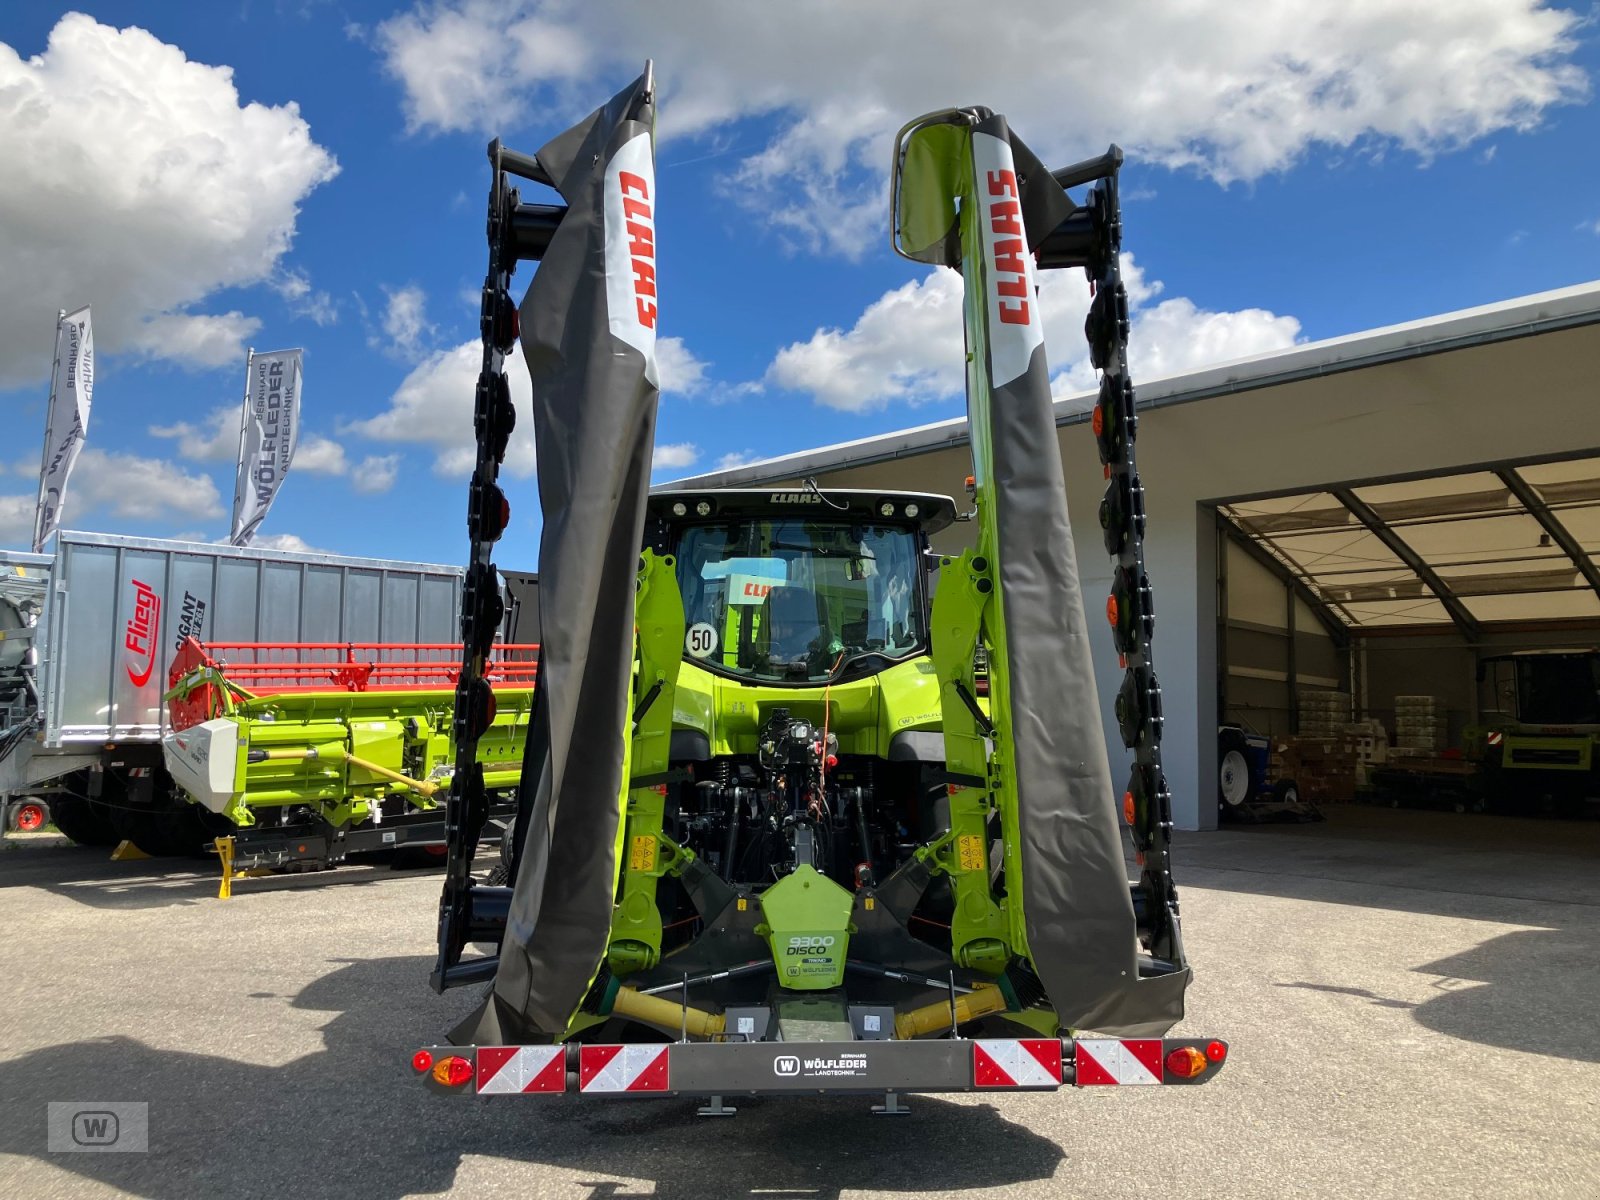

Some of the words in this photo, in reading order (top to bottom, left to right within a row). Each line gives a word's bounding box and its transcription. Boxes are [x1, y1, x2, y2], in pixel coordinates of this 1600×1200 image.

[619, 171, 657, 329] CLAAS
[987, 169, 1030, 325] CLAAS
[67, 324, 77, 389] BERNHARD
[255, 363, 267, 420] BERNHARD
[254, 360, 284, 507] WÖLFLEDER
[770, 493, 822, 504] CLAAS
[743, 582, 773, 597] CLA
[126, 578, 157, 655] Fliegl
[691, 629, 712, 652] 50
[786, 946, 827, 956] DISCO
[789, 935, 835, 947] 9300
[803, 1058, 867, 1069] WÖLFLEDER
